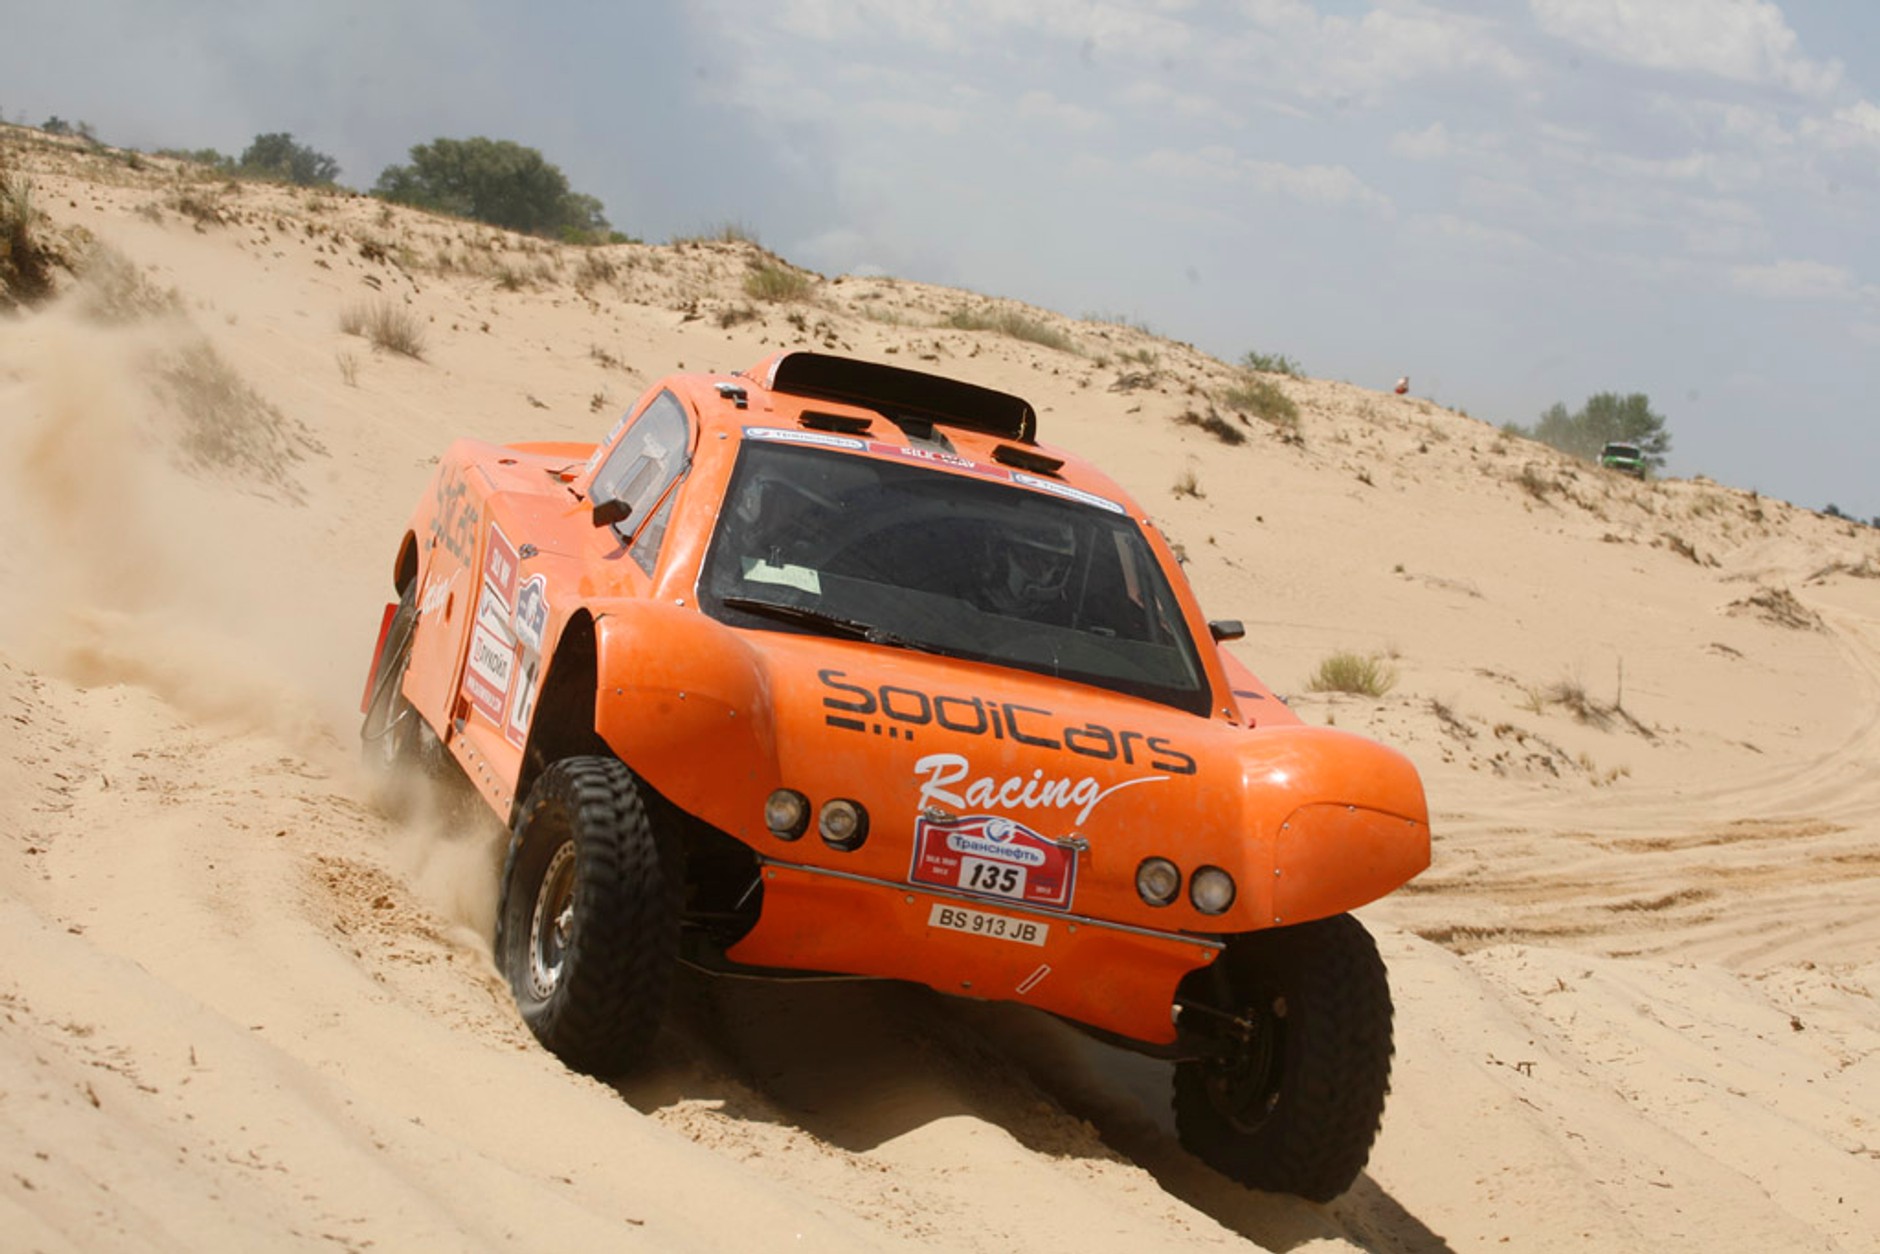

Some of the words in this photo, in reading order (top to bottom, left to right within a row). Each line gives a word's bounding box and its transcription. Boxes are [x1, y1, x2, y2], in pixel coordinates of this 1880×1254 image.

[913, 752, 1171, 826] Racing
[952, 834, 1041, 862] Транснефть
[969, 863, 1019, 893] 135
[939, 908, 968, 929] BS
[971, 913, 1006, 937] 913
[1009, 921, 1038, 943] JB
